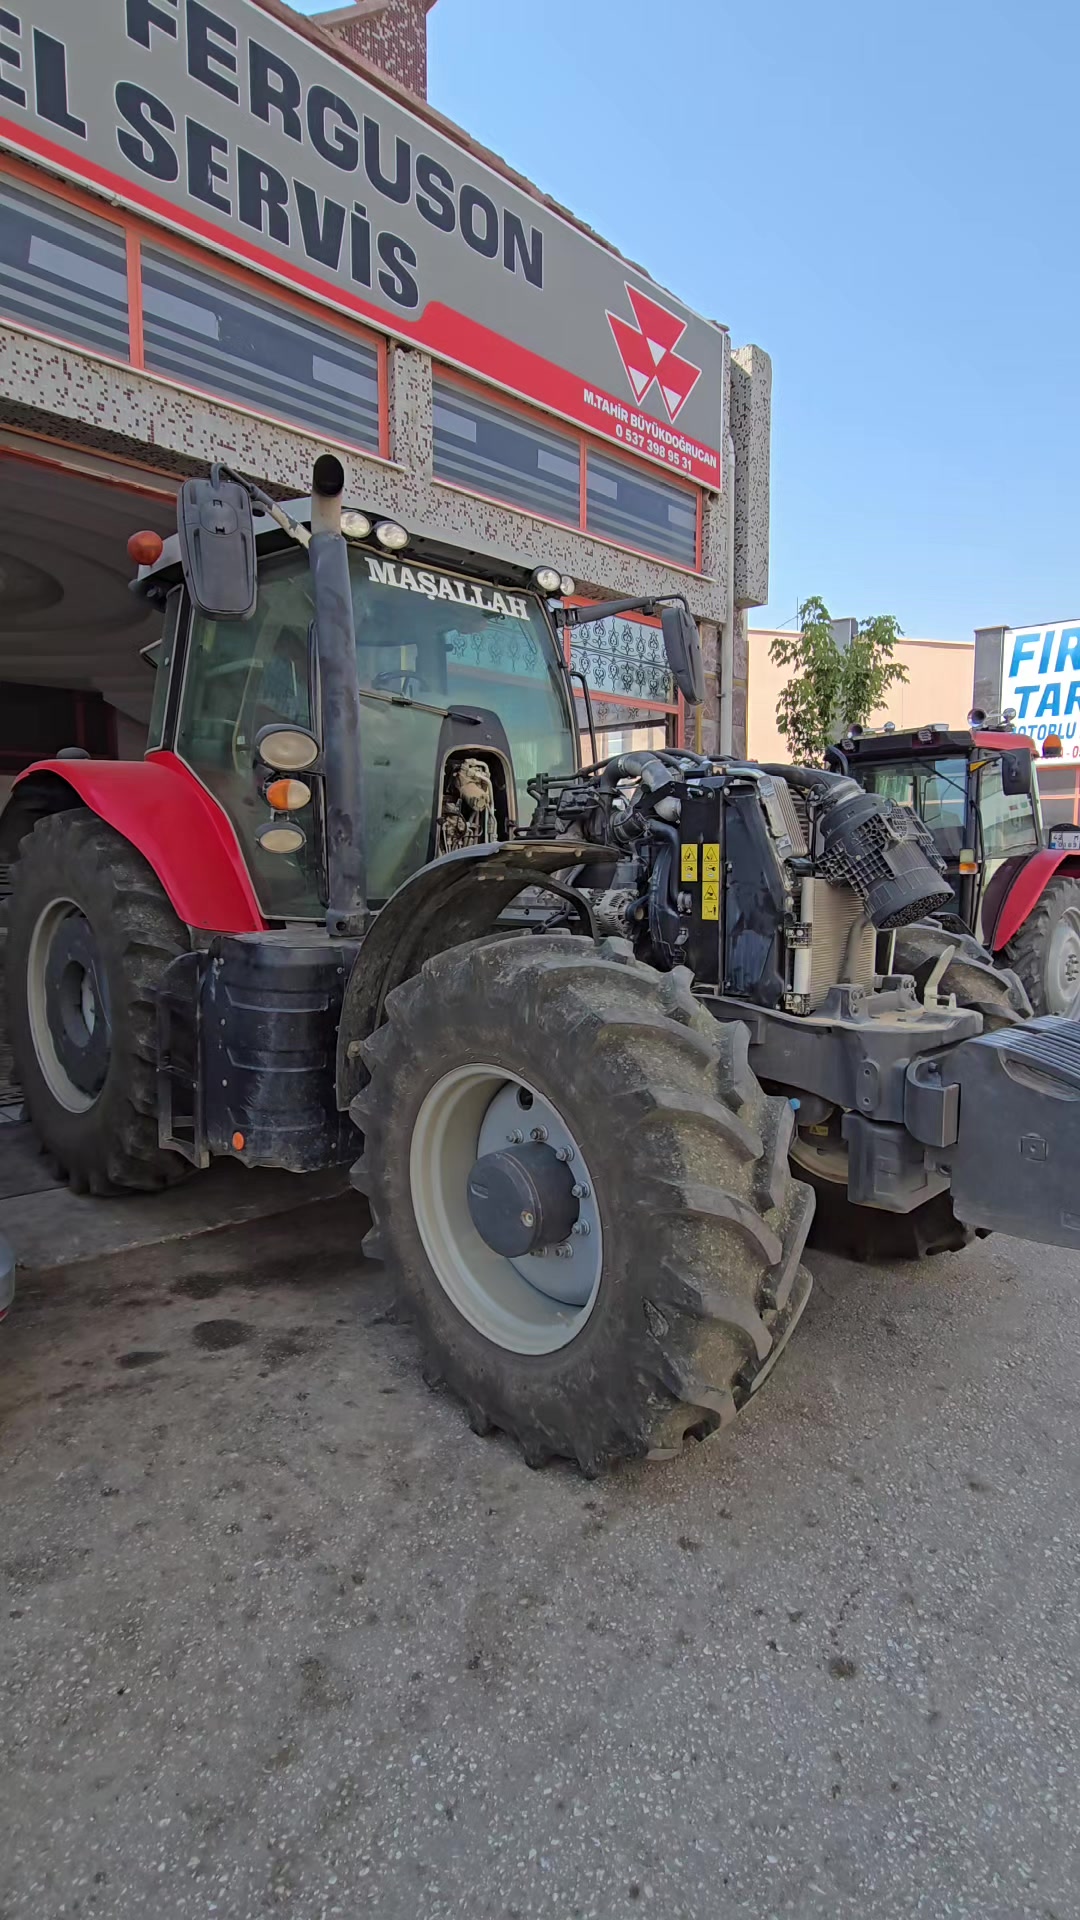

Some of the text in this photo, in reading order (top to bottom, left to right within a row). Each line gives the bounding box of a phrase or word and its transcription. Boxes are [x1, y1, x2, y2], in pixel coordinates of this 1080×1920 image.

[114, 80, 420, 310] SERVİS
[583, 388, 717, 469] M.TAHİR BÜYÜKDOĞRUCAN
[615, 424, 692, 472] 0 537 398 95 31
[364, 556, 531, 622] MAŞALLAH
[1008, 627, 1080, 678] FIR
[1012, 721, 1077, 741] OTORLU
